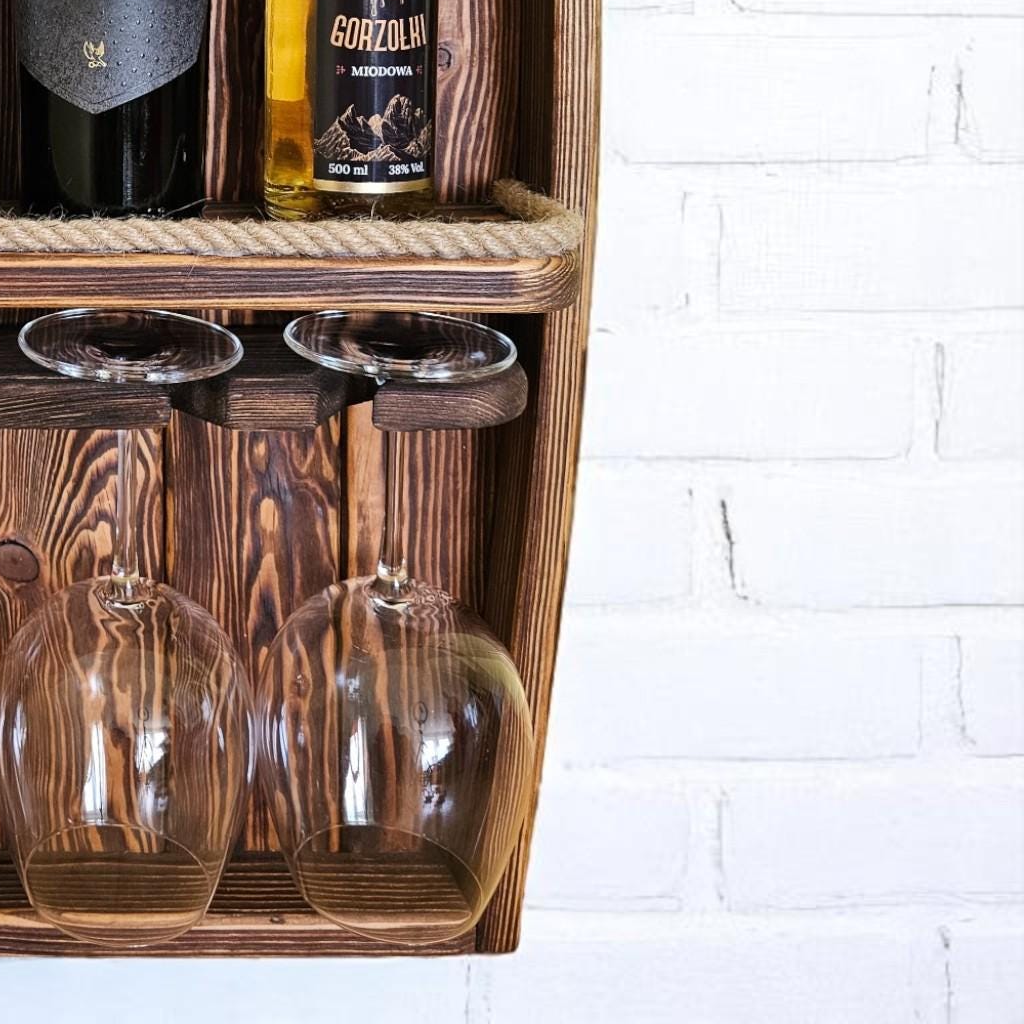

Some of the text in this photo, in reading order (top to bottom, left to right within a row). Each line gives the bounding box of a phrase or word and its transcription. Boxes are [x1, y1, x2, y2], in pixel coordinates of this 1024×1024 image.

[351, 65, 413, 77] MIODOWA
[328, 163, 351, 175] 500
[353, 163, 369, 176] ml
[388, 163, 410, 176] 38%
